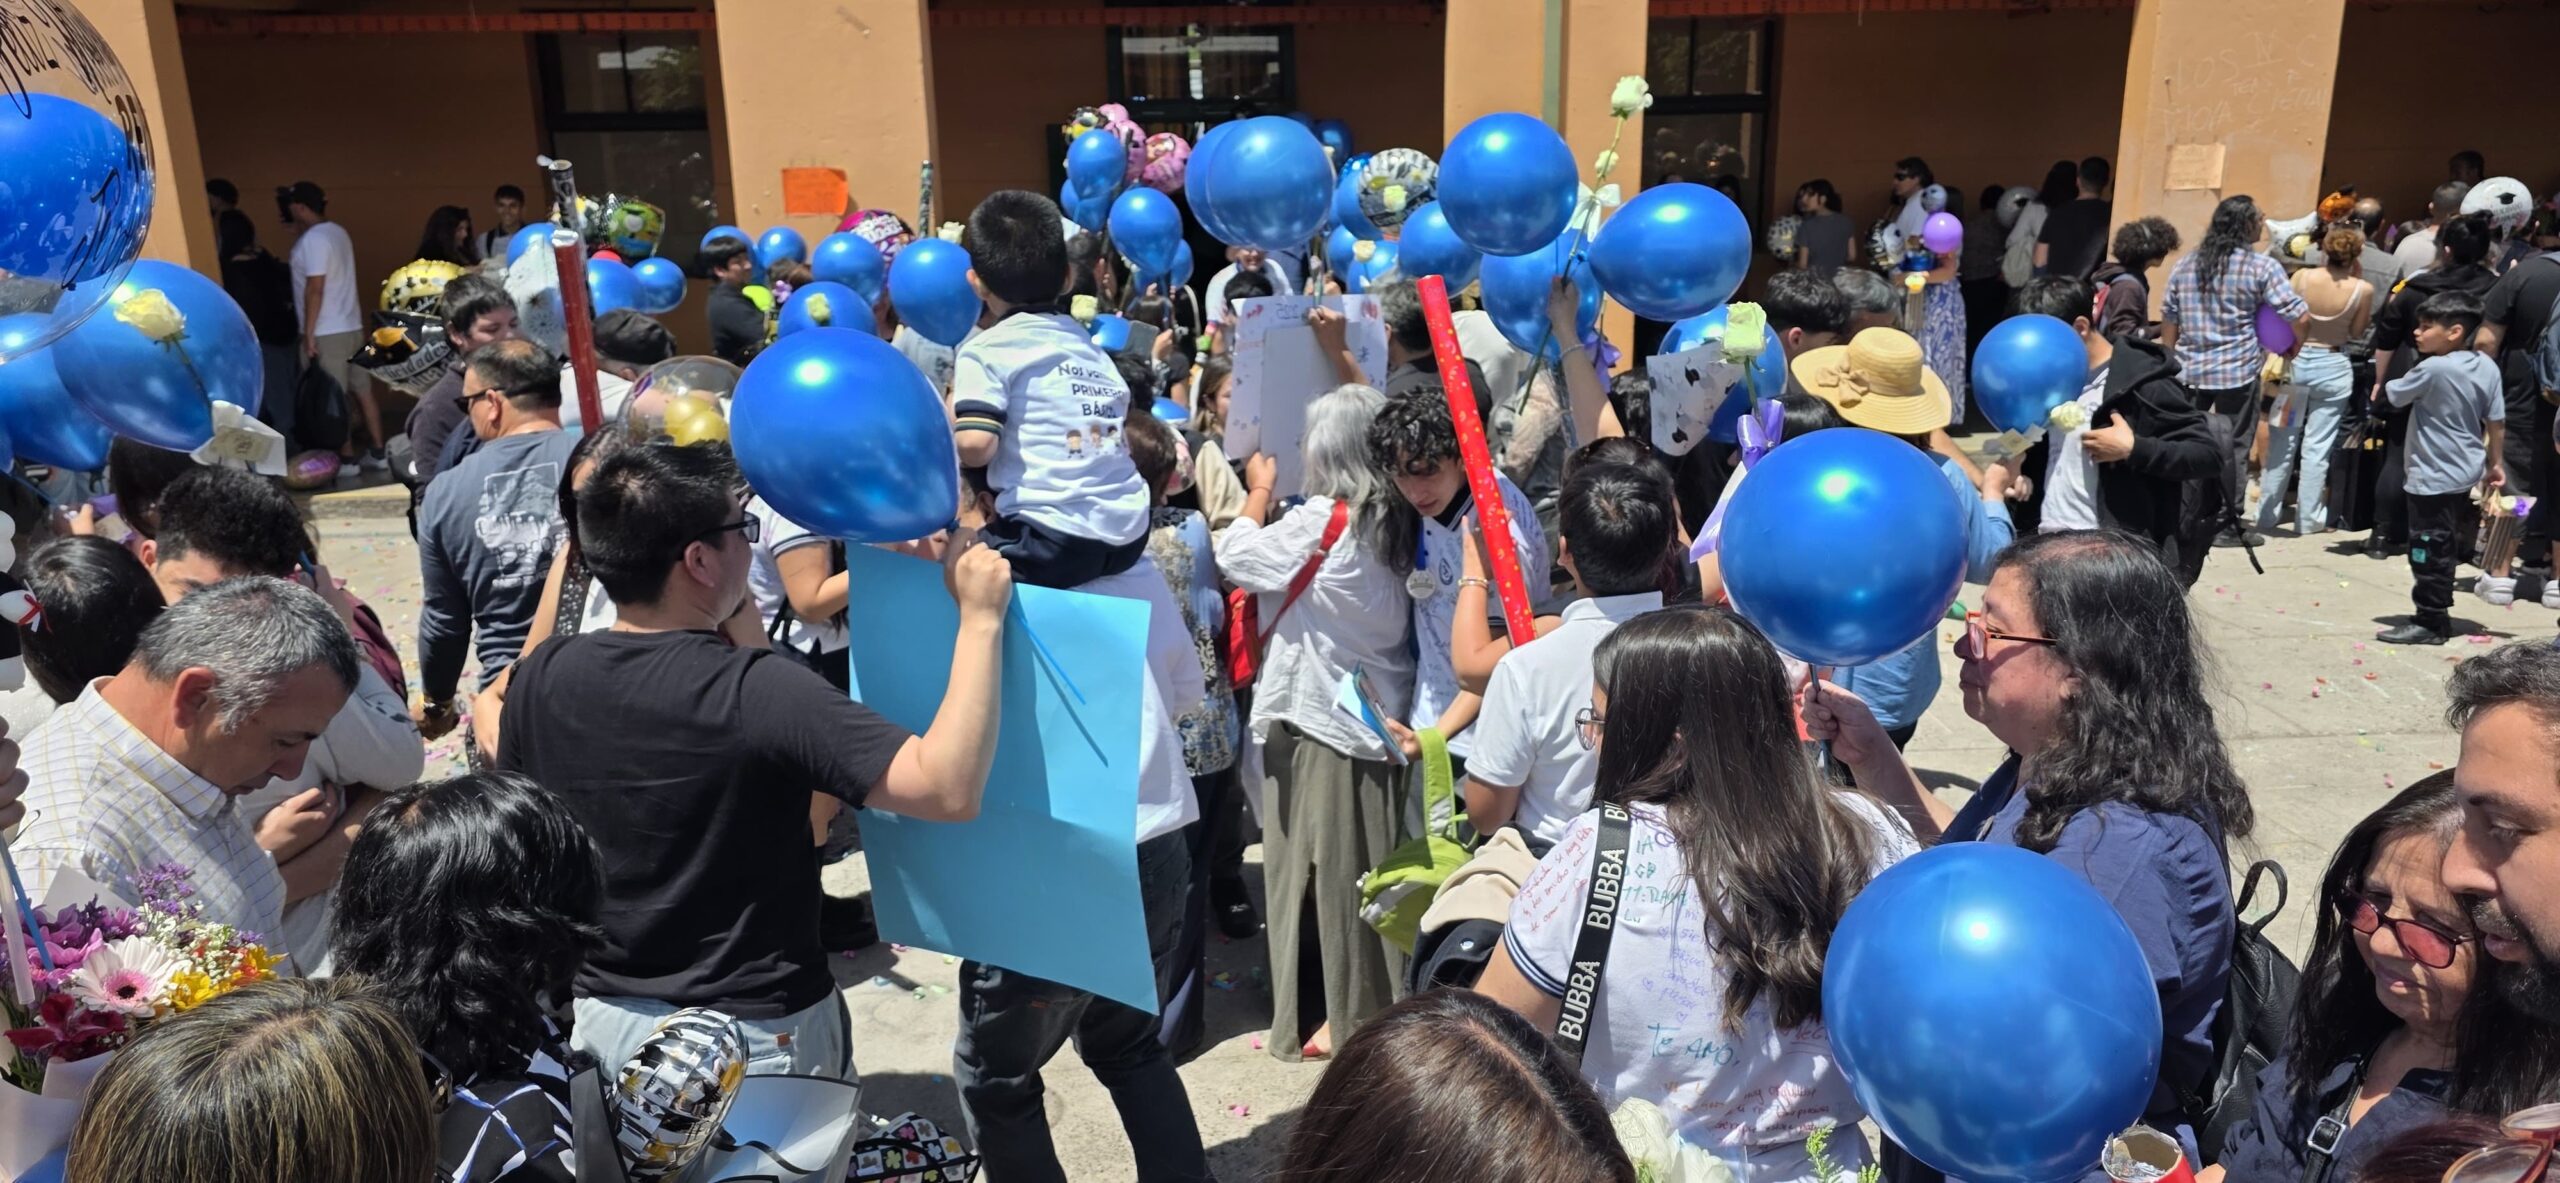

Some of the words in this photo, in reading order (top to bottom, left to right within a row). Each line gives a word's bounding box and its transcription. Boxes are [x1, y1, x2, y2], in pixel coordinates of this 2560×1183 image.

[1058, 364, 1083, 376] Nos
[1586, 848, 1625, 930] BUBBA
[1558, 961, 1600, 1041] BUBBA
